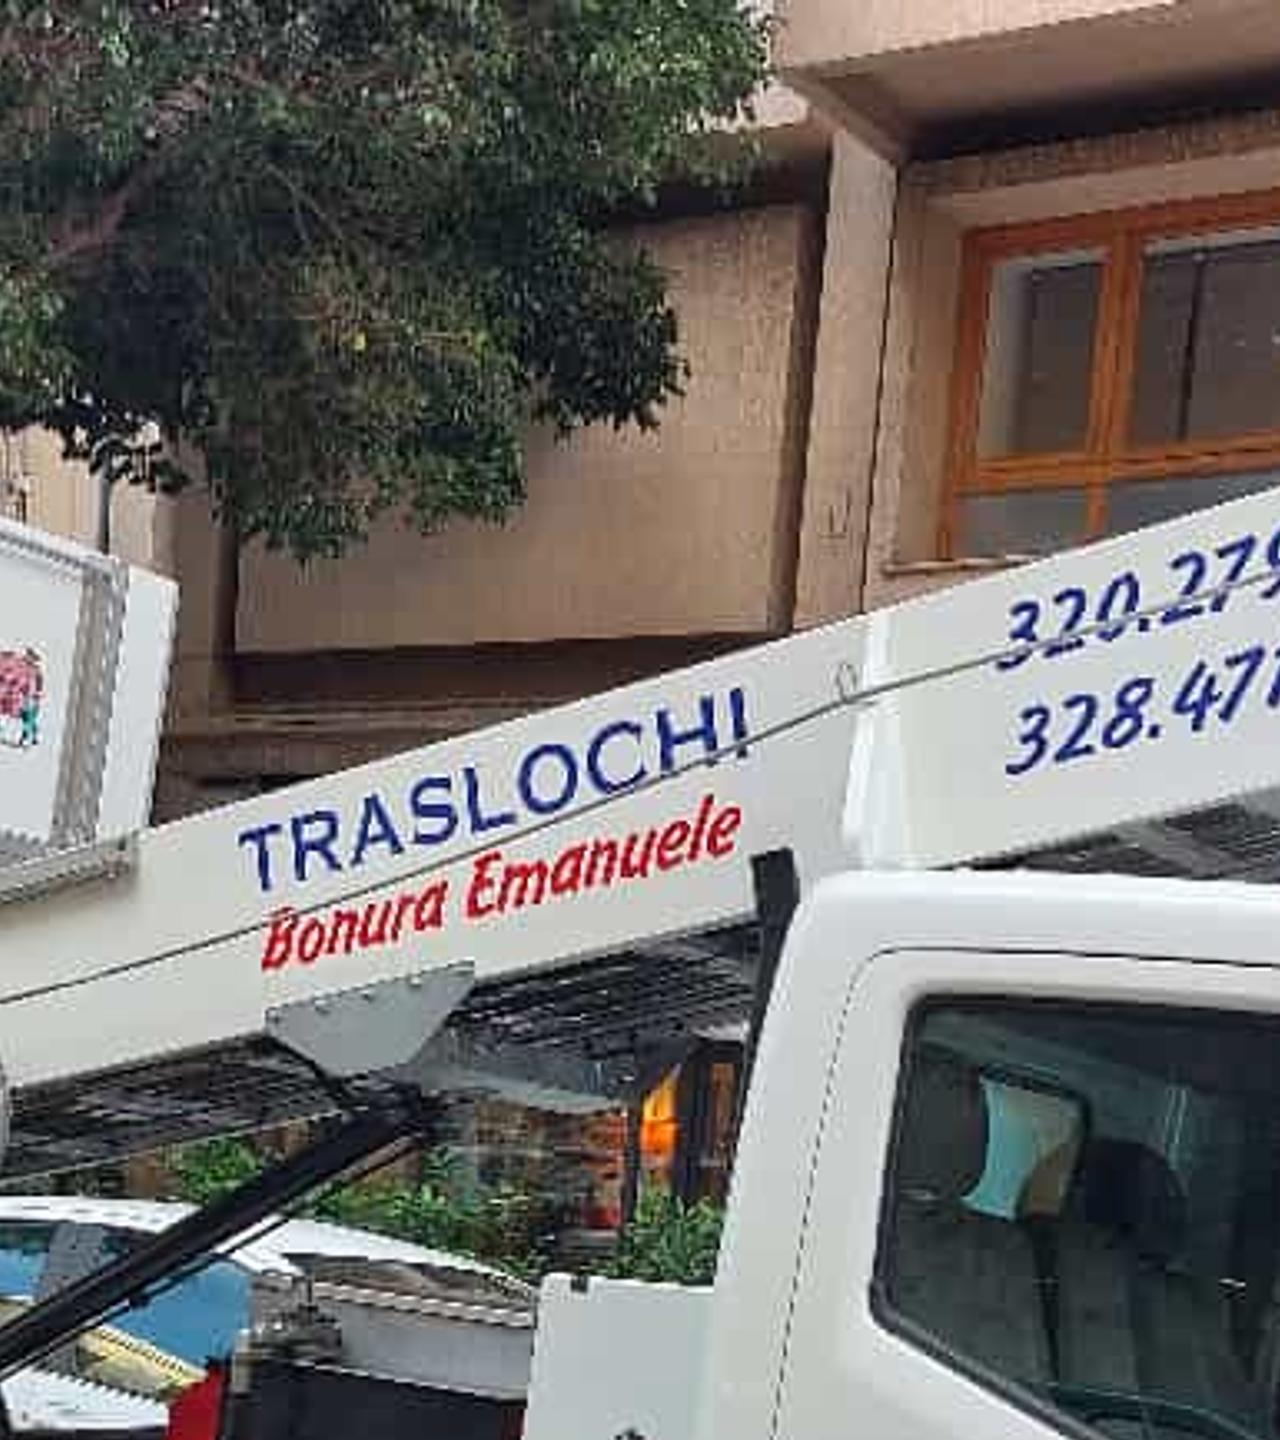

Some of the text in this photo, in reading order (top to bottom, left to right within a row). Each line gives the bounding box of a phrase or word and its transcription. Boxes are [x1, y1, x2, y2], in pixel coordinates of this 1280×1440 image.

[238, 687, 749, 892] TRASLOCHI
[261, 795, 742, 971] Bonura Emanuele
